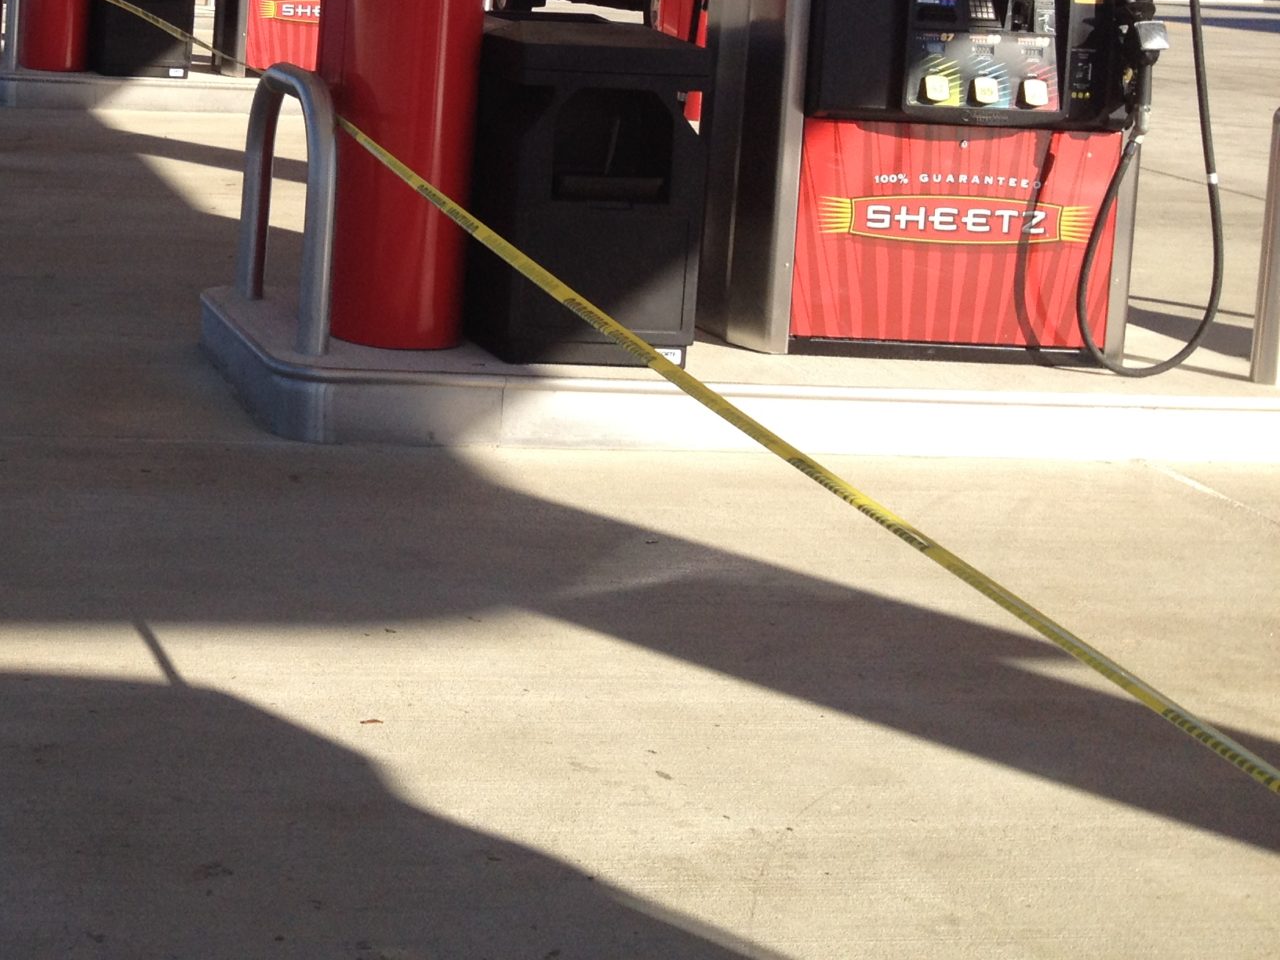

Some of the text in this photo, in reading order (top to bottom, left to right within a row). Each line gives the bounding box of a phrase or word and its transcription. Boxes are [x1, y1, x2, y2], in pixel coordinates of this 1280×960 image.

[282, 4, 320, 16] SHE
[940, 32, 955, 42] 87
[874, 173, 1041, 190] 100% GUARANTEED
[866, 205, 1046, 234] SHEETZ
